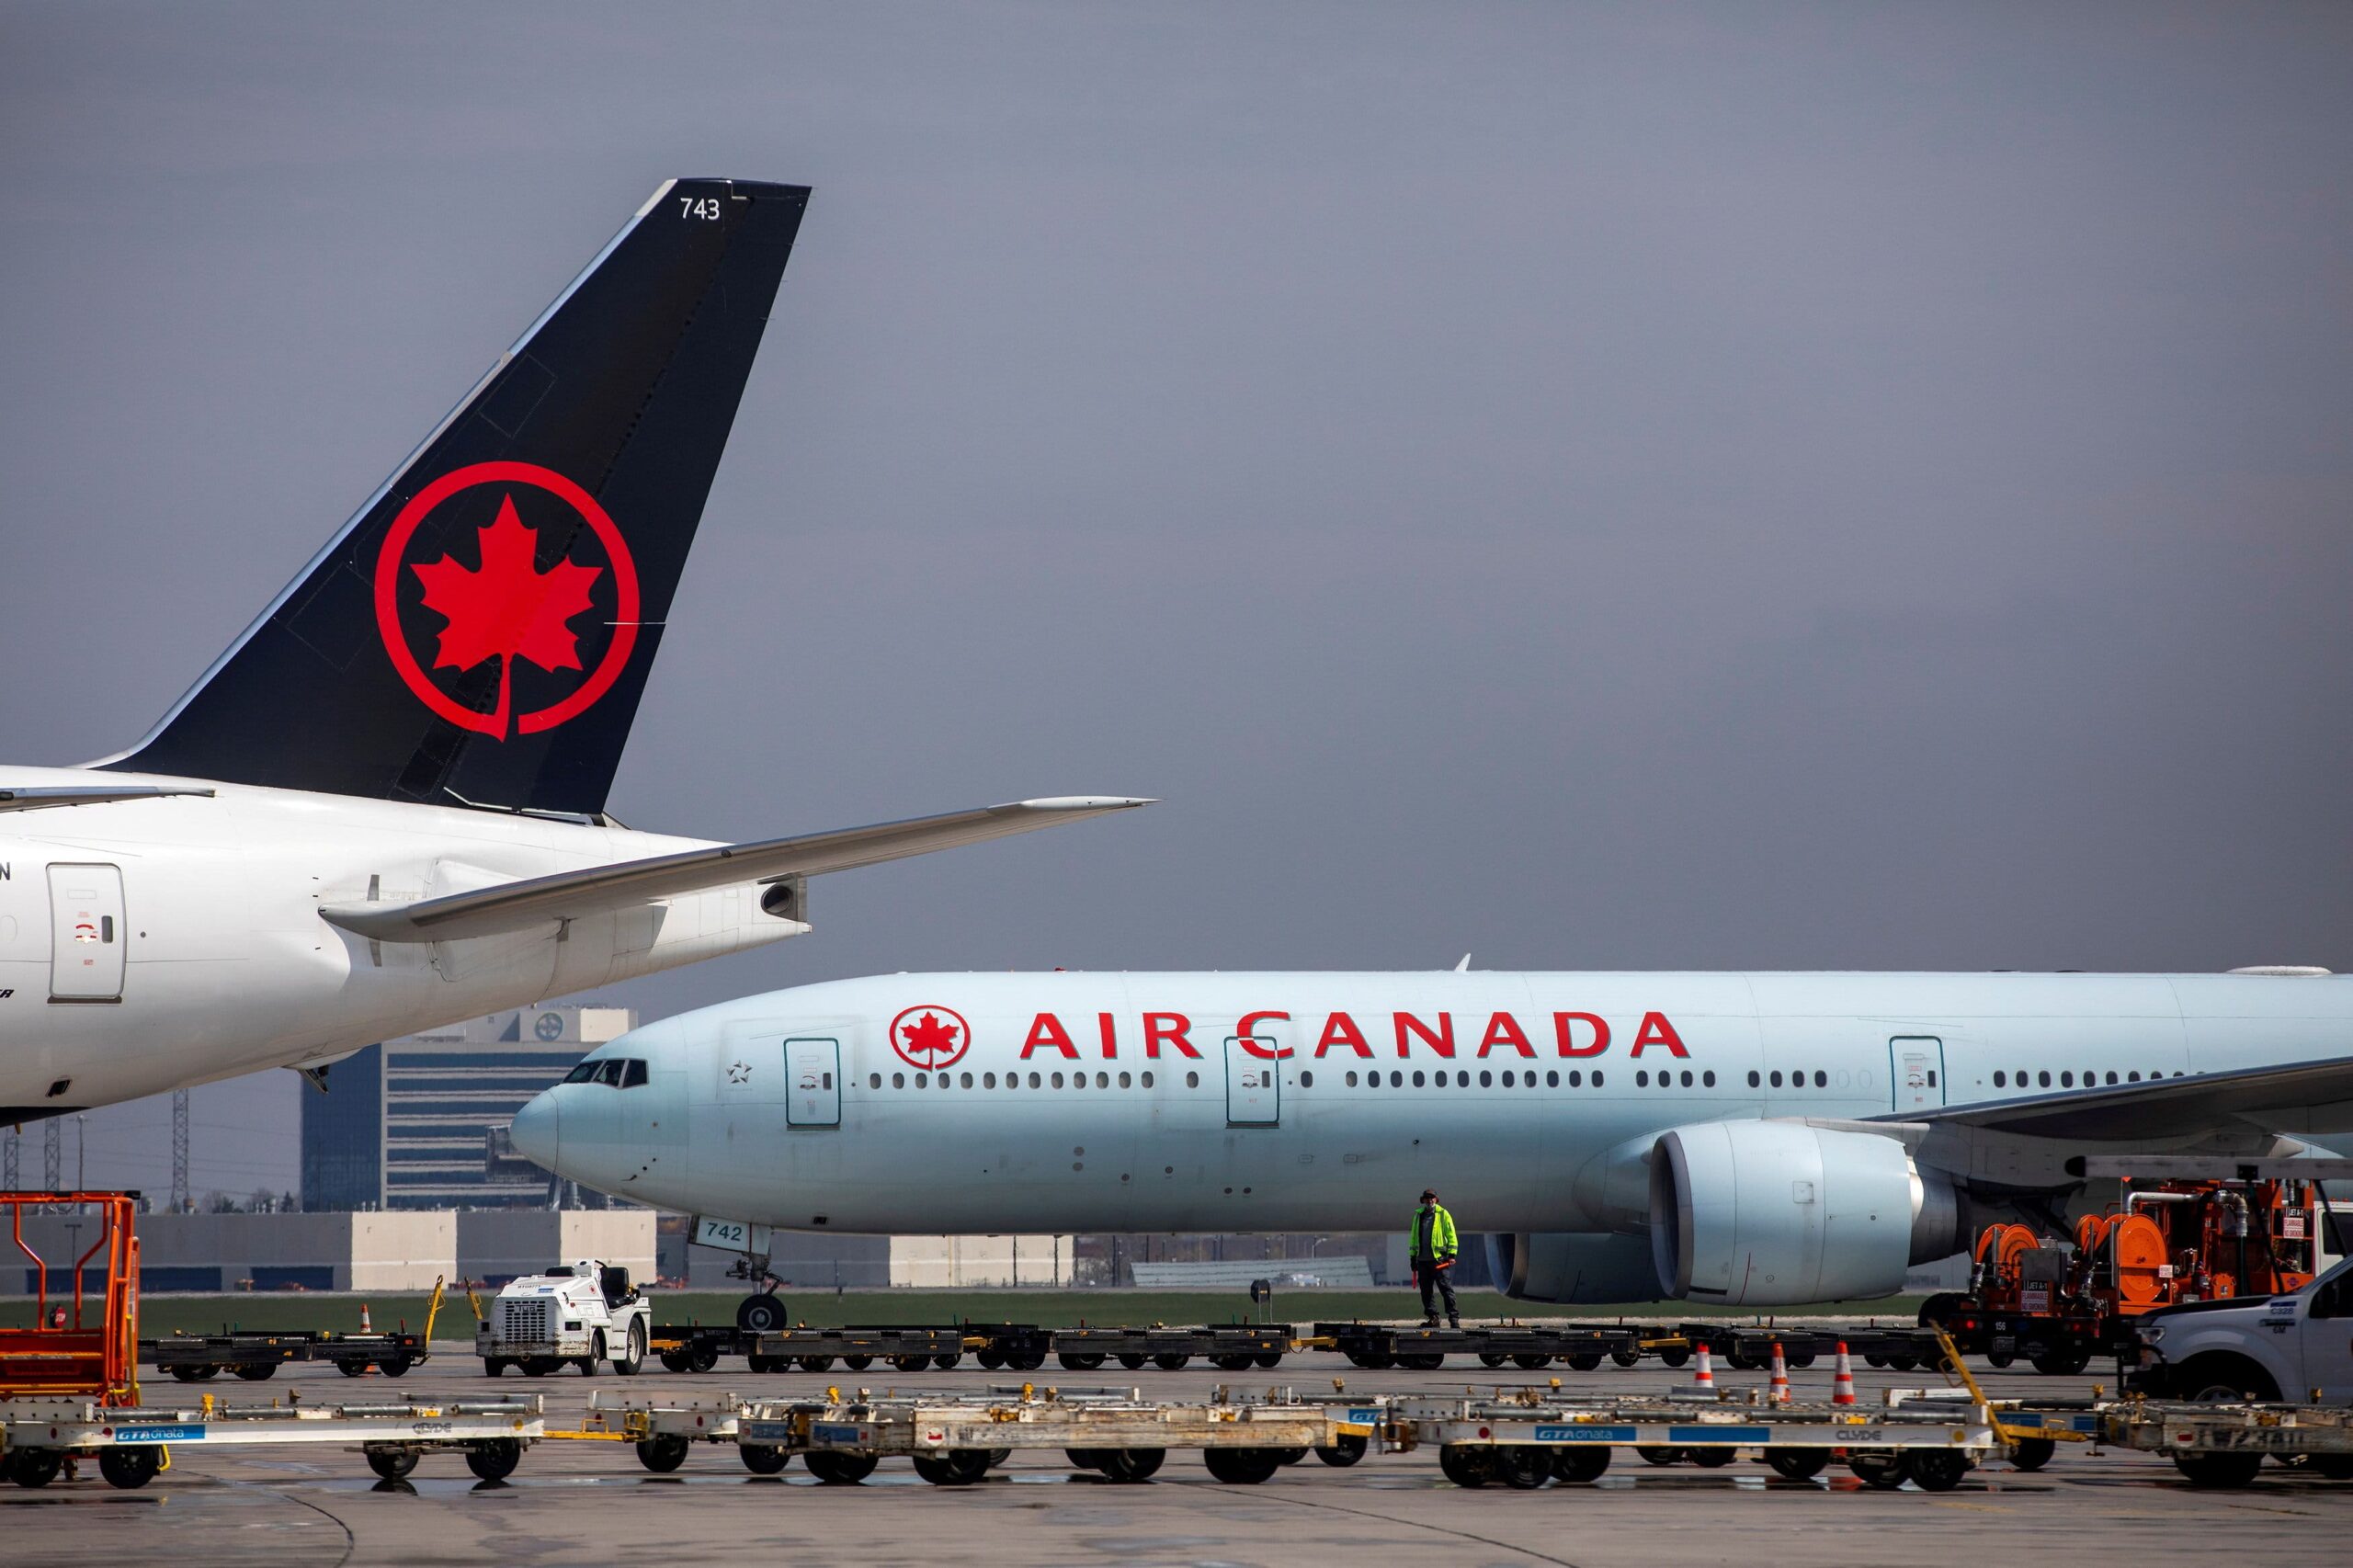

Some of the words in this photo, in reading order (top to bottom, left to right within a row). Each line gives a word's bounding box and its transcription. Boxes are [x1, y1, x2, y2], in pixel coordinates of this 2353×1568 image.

[680, 197, 721, 222] 743
[1019, 1011, 1204, 1060] AIR
[1236, 1010, 1690, 1060] CANADA
[707, 1222, 743, 1242] 742
[2029, 1281, 2038, 1290] JET
[2039, 1281, 2048, 1290] A-1
[2029, 1302, 2048, 1311] SMOKING
[1995, 1322, 2006, 1331] 156
[118, 1430, 150, 1440] GTA
[151, 1428, 184, 1439] dnata
[1539, 1430, 1574, 1439] GTA
[1574, 1429, 1613, 1439] dnata
[1836, 1430, 1882, 1441] CLYDE
